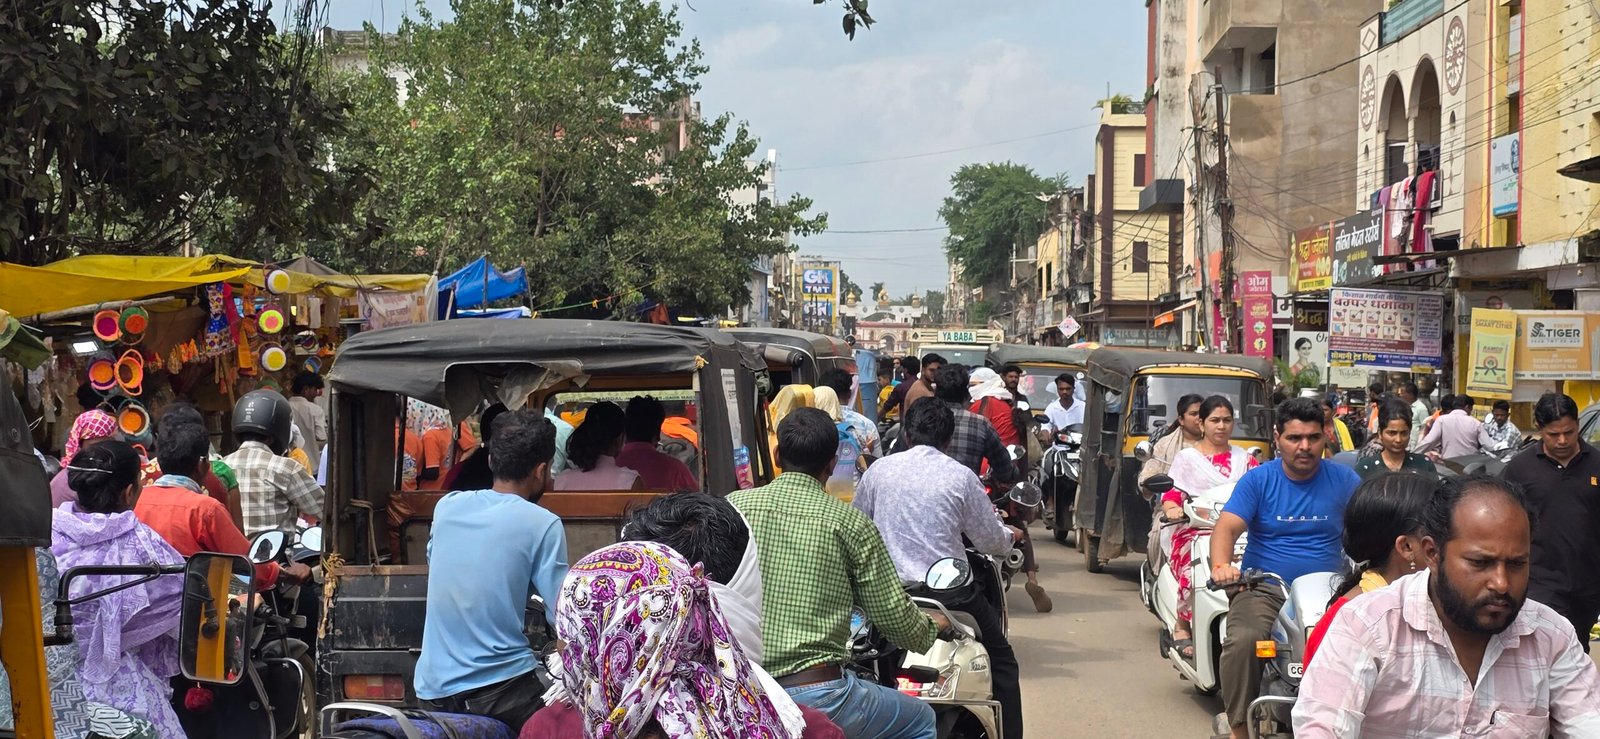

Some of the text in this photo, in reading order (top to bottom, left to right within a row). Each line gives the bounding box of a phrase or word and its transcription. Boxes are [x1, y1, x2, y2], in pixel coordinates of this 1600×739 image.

[1351, 226, 1365, 248] मेटल
[804, 269, 830, 284] GK
[805, 285, 830, 294] TMT
[1334, 298, 1367, 308] बम्पर
[1371, 300, 1414, 311] धमाका
[943, 332, 974, 342] YA BABA
[1545, 328, 1581, 338] TIGER
